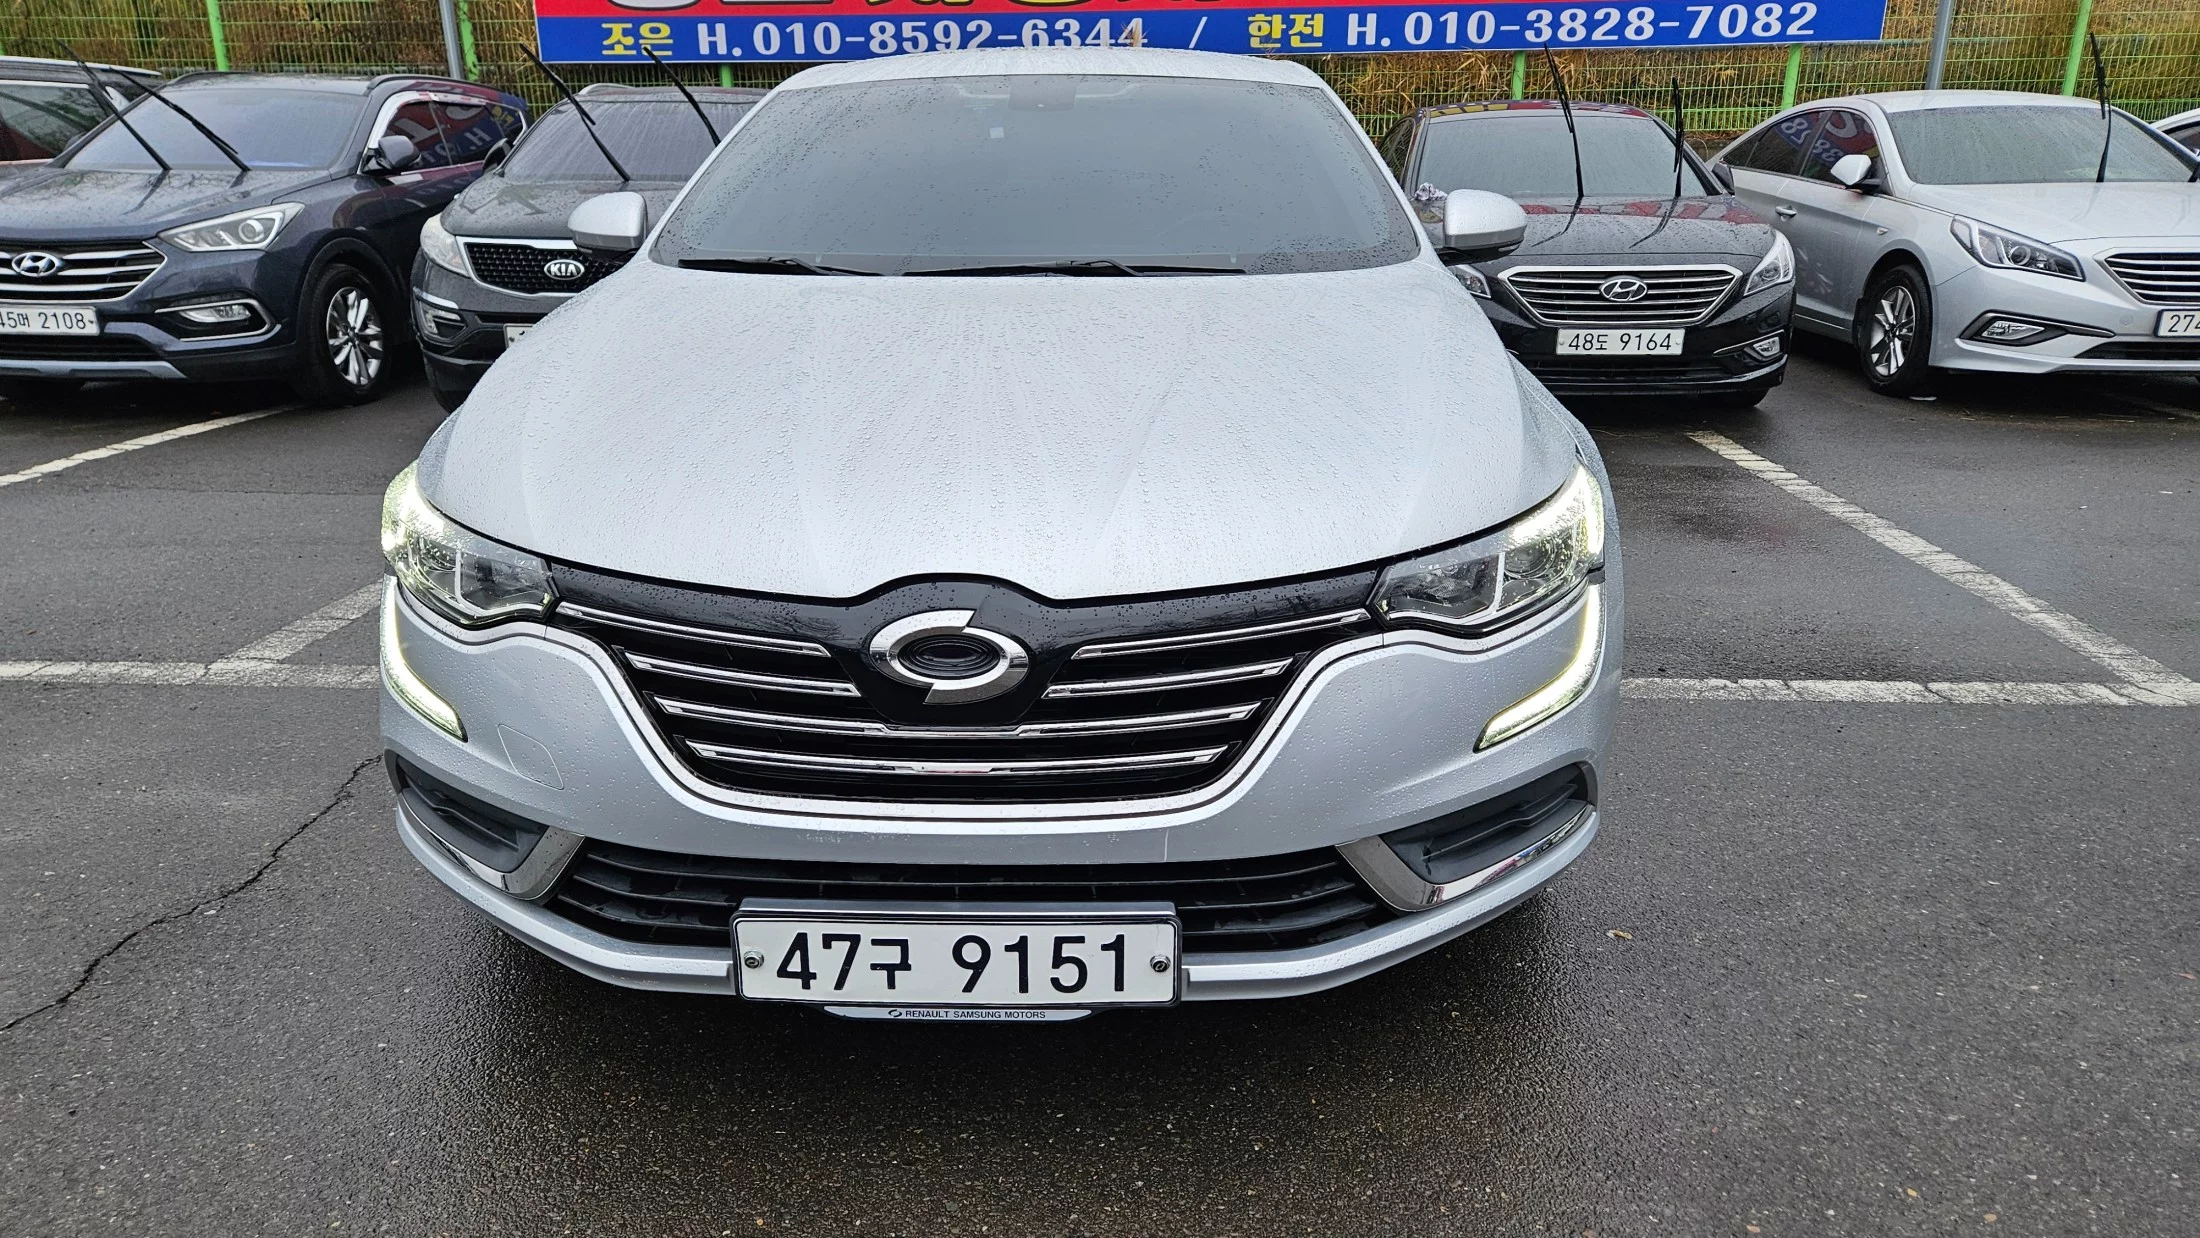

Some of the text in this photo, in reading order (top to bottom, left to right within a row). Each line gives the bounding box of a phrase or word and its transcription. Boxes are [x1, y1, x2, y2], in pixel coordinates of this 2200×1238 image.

[601, 22, 674, 56] 조은
[1248, 13, 1325, 49] 한전
[38, 312, 86, 330] 2108
[1568, 333, 1671, 351] 48도 9164
[776, 931, 1126, 994] 47구 9151
[905, 1009, 1046, 1019] RENAULT SAMSUNG MOTORS
